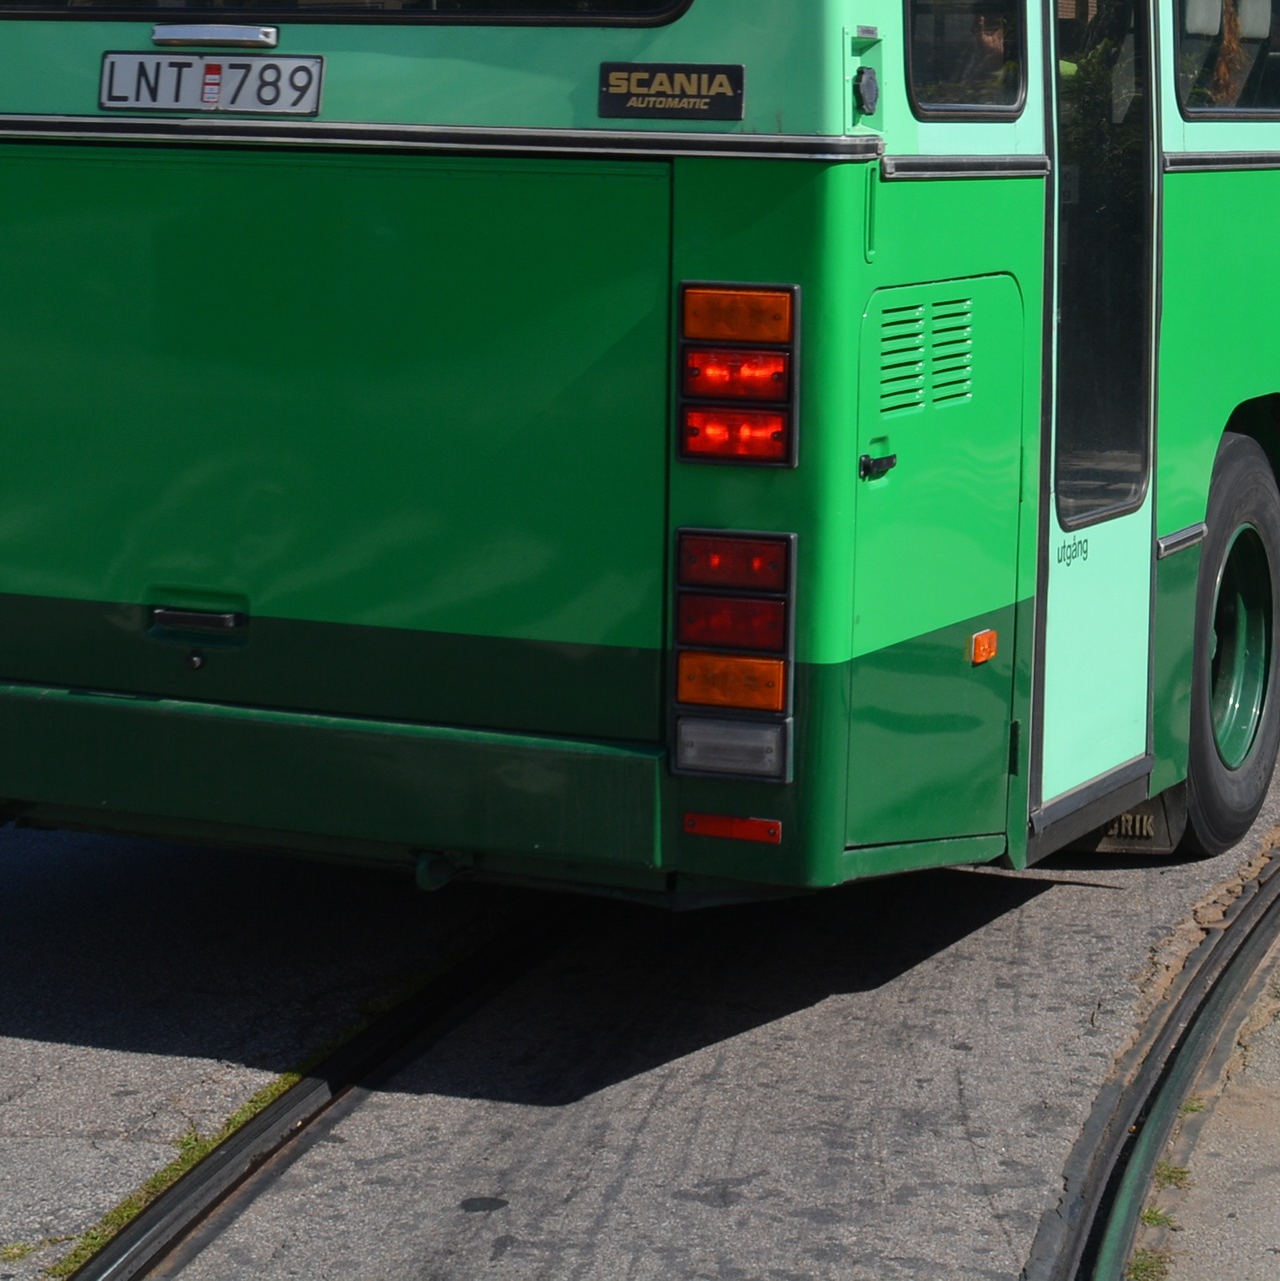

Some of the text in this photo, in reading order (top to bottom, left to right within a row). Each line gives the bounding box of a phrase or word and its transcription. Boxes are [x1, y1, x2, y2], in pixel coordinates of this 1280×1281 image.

[107, 61, 193, 103] LNT
[228, 63, 313, 107] 789
[608, 71, 734, 96] SCANIA
[626, 96, 711, 110] AUTOMATIC
[1057, 534, 1088, 567] utgång
